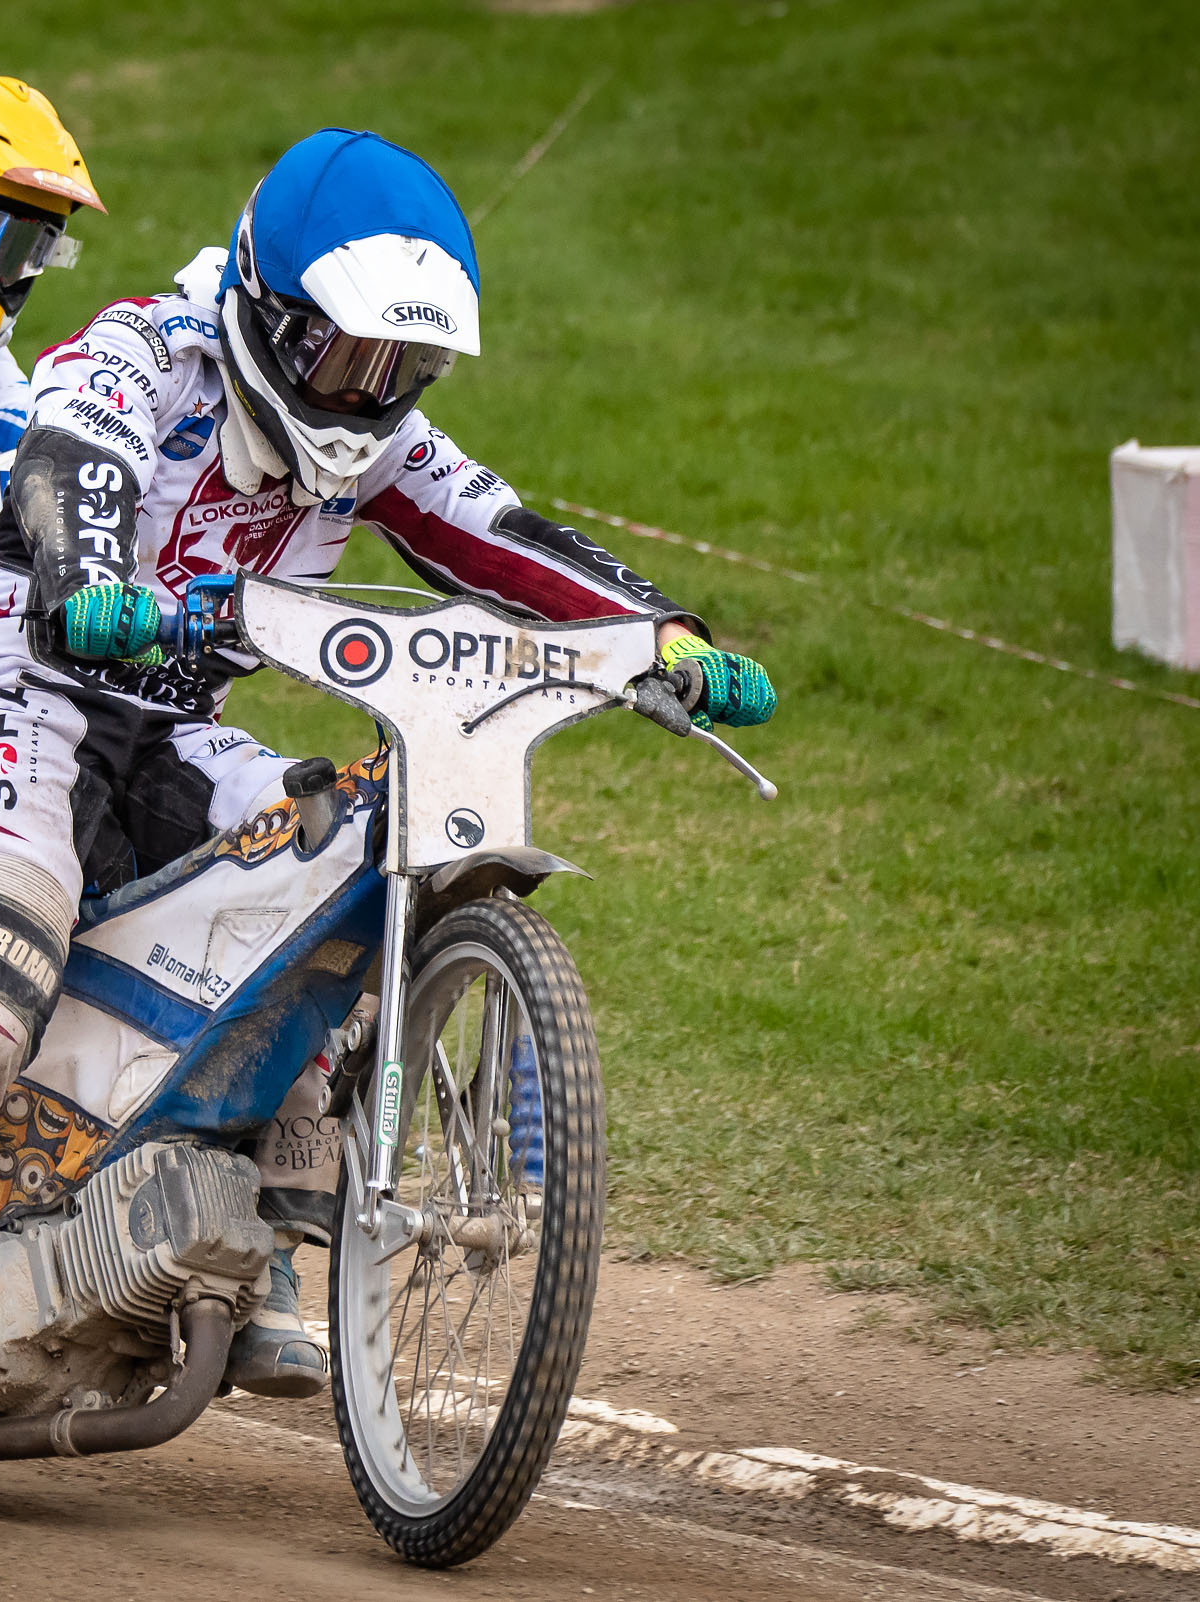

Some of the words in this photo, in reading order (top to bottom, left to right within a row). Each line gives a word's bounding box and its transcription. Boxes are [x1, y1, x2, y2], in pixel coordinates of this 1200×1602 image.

[272, 314, 291, 345] OAKLEY
[393, 305, 450, 331] SHOEI
[188, 494, 289, 527] LOKOMO
[275, 512, 295, 525] CLUB
[408, 627, 581, 682] OPTIBET
[412, 672, 507, 692] SPORTA
[541, 687, 576, 704] ARS
[382, 1075, 399, 1132] stuha
[274, 1116, 341, 1140] YOG
